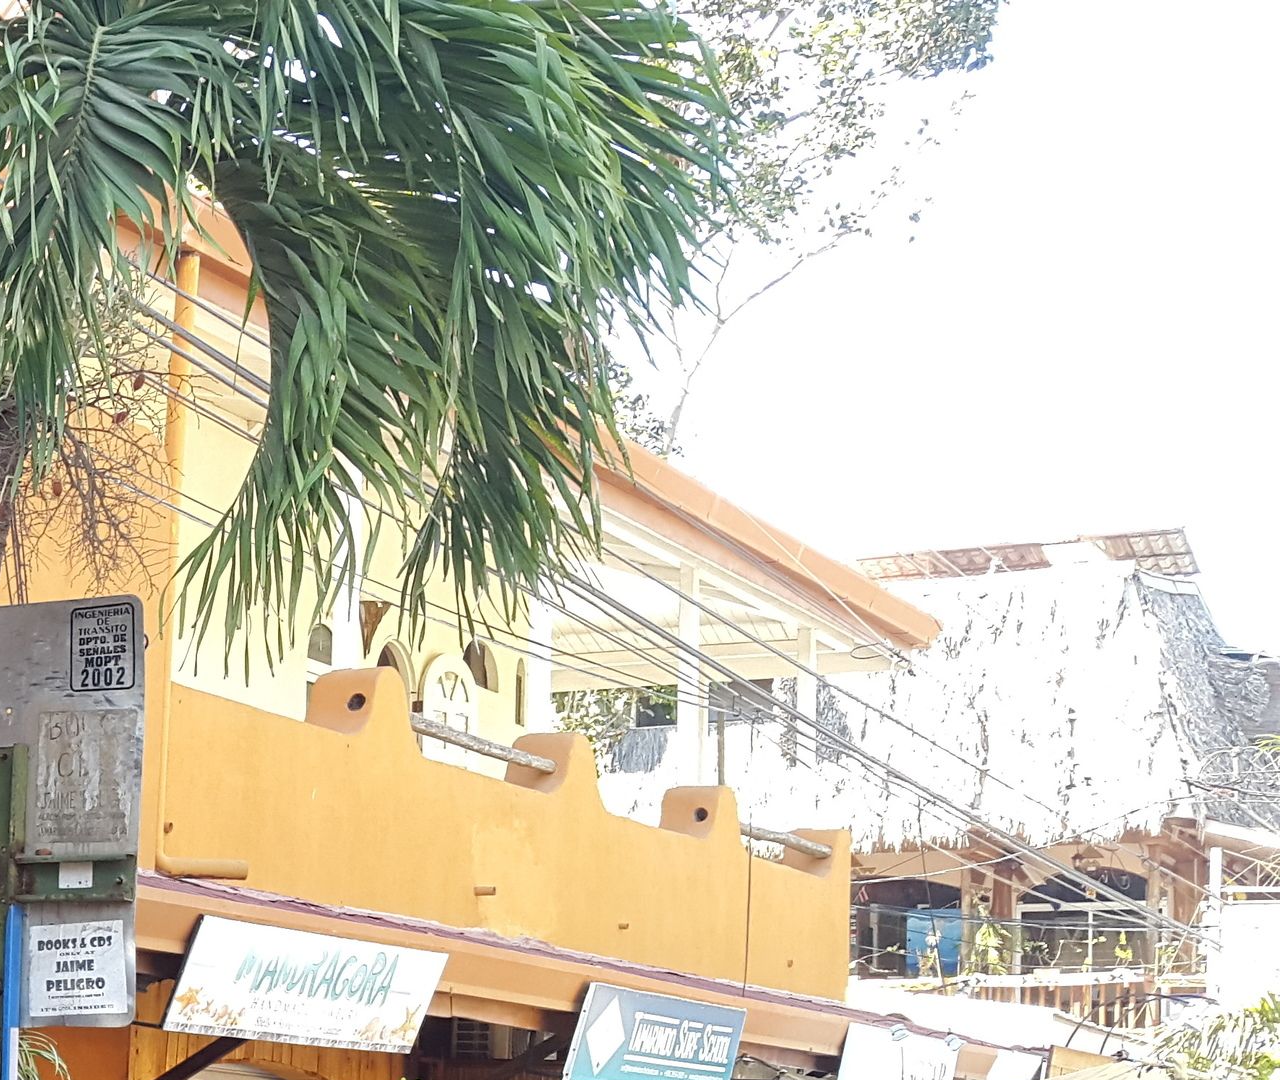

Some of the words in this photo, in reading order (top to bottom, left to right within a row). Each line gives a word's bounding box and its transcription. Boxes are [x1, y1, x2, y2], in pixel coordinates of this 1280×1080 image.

[74, 607, 131, 620] INGENIERIA
[96, 617, 110, 626] DE
[78, 623, 128, 636] TRANSITO
[78, 635, 110, 647] DPTO.
[112, 633, 127, 643] DE
[84, 654, 122, 669] MOPT
[80, 666, 126, 688] 2002
[37, 937, 78, 952] BOOKS
[79, 937, 87, 949] &
[89, 935, 113, 948] CDS
[54, 959, 95, 974] JAIME
[45, 977, 106, 992] PELIGRO
